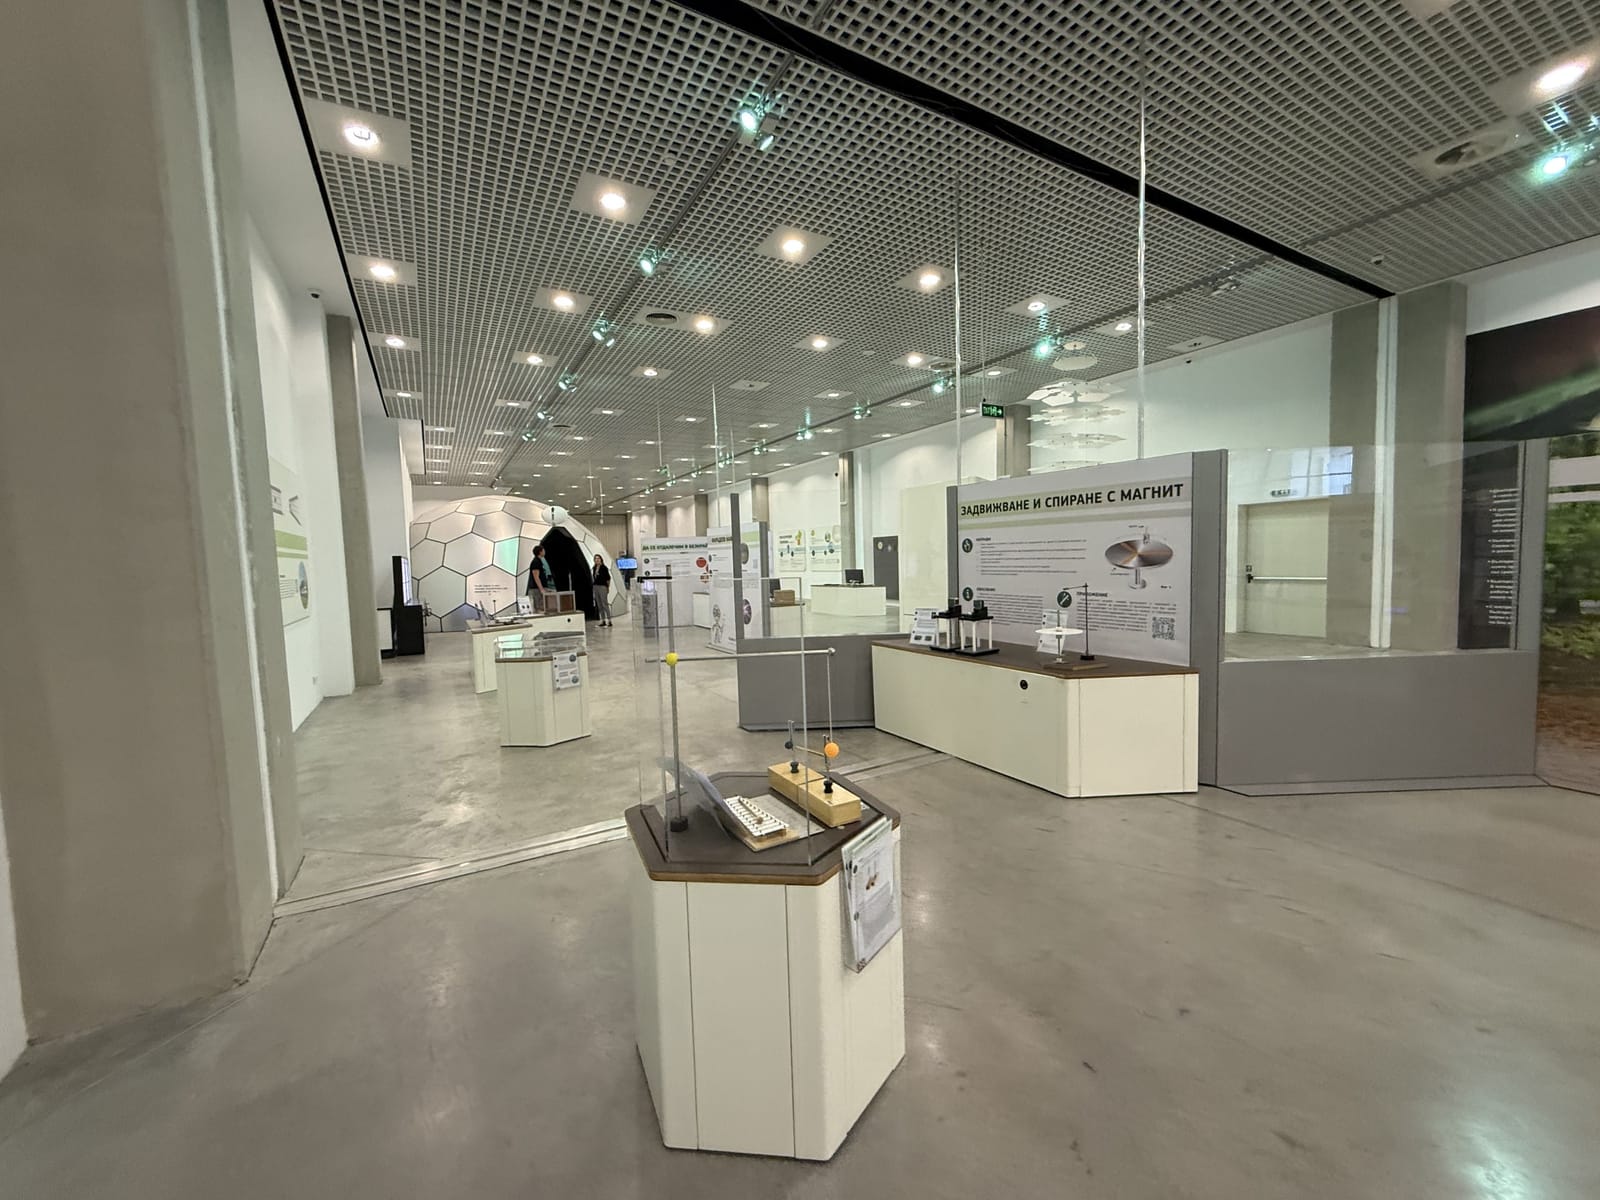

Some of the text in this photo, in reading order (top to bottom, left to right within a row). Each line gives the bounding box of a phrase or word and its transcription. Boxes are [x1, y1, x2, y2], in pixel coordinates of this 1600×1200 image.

[960, 483, 1184, 516] ЗАДВИЖВАНЕ И СПИРАНЕ С МАГНИТ
